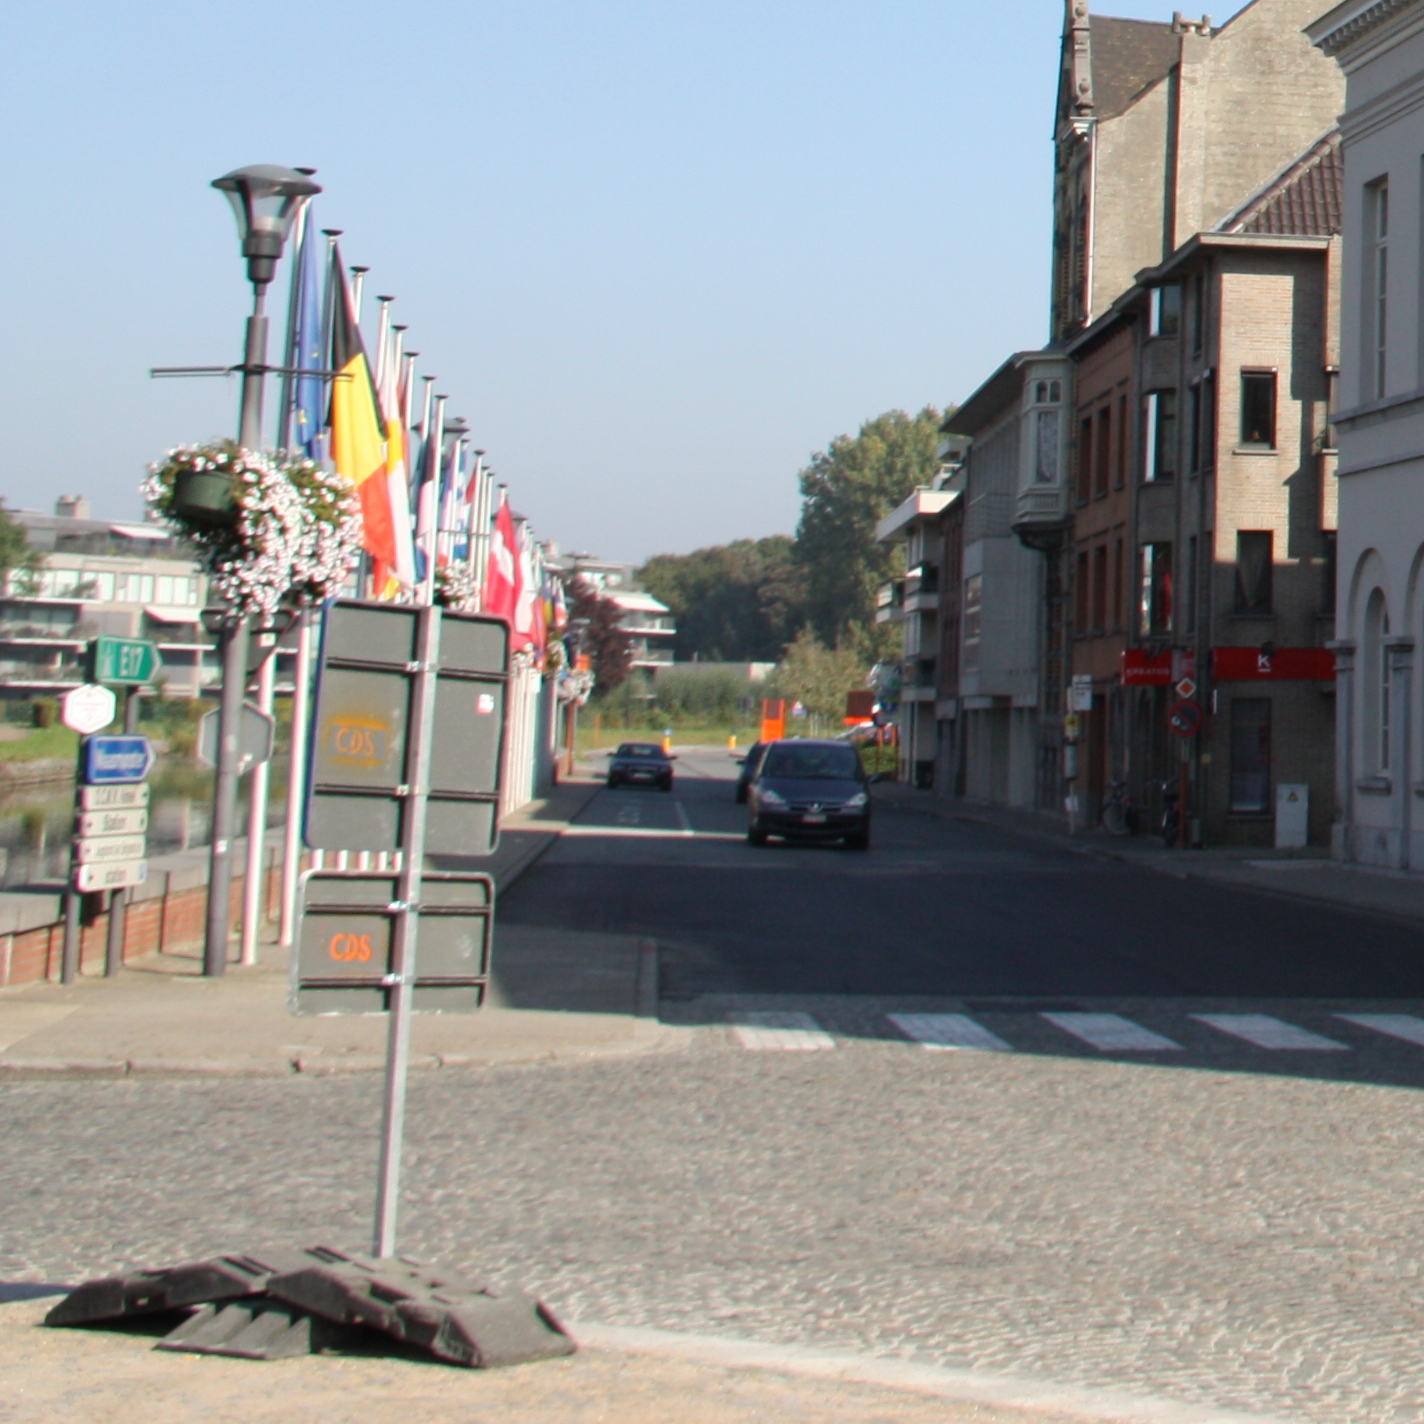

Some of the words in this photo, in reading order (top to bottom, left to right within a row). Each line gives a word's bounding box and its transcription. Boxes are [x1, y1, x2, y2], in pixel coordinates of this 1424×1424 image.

[119, 646, 143, 677] E17
[335, 727, 375, 756] CDS
[329, 933, 373, 962] CDS
